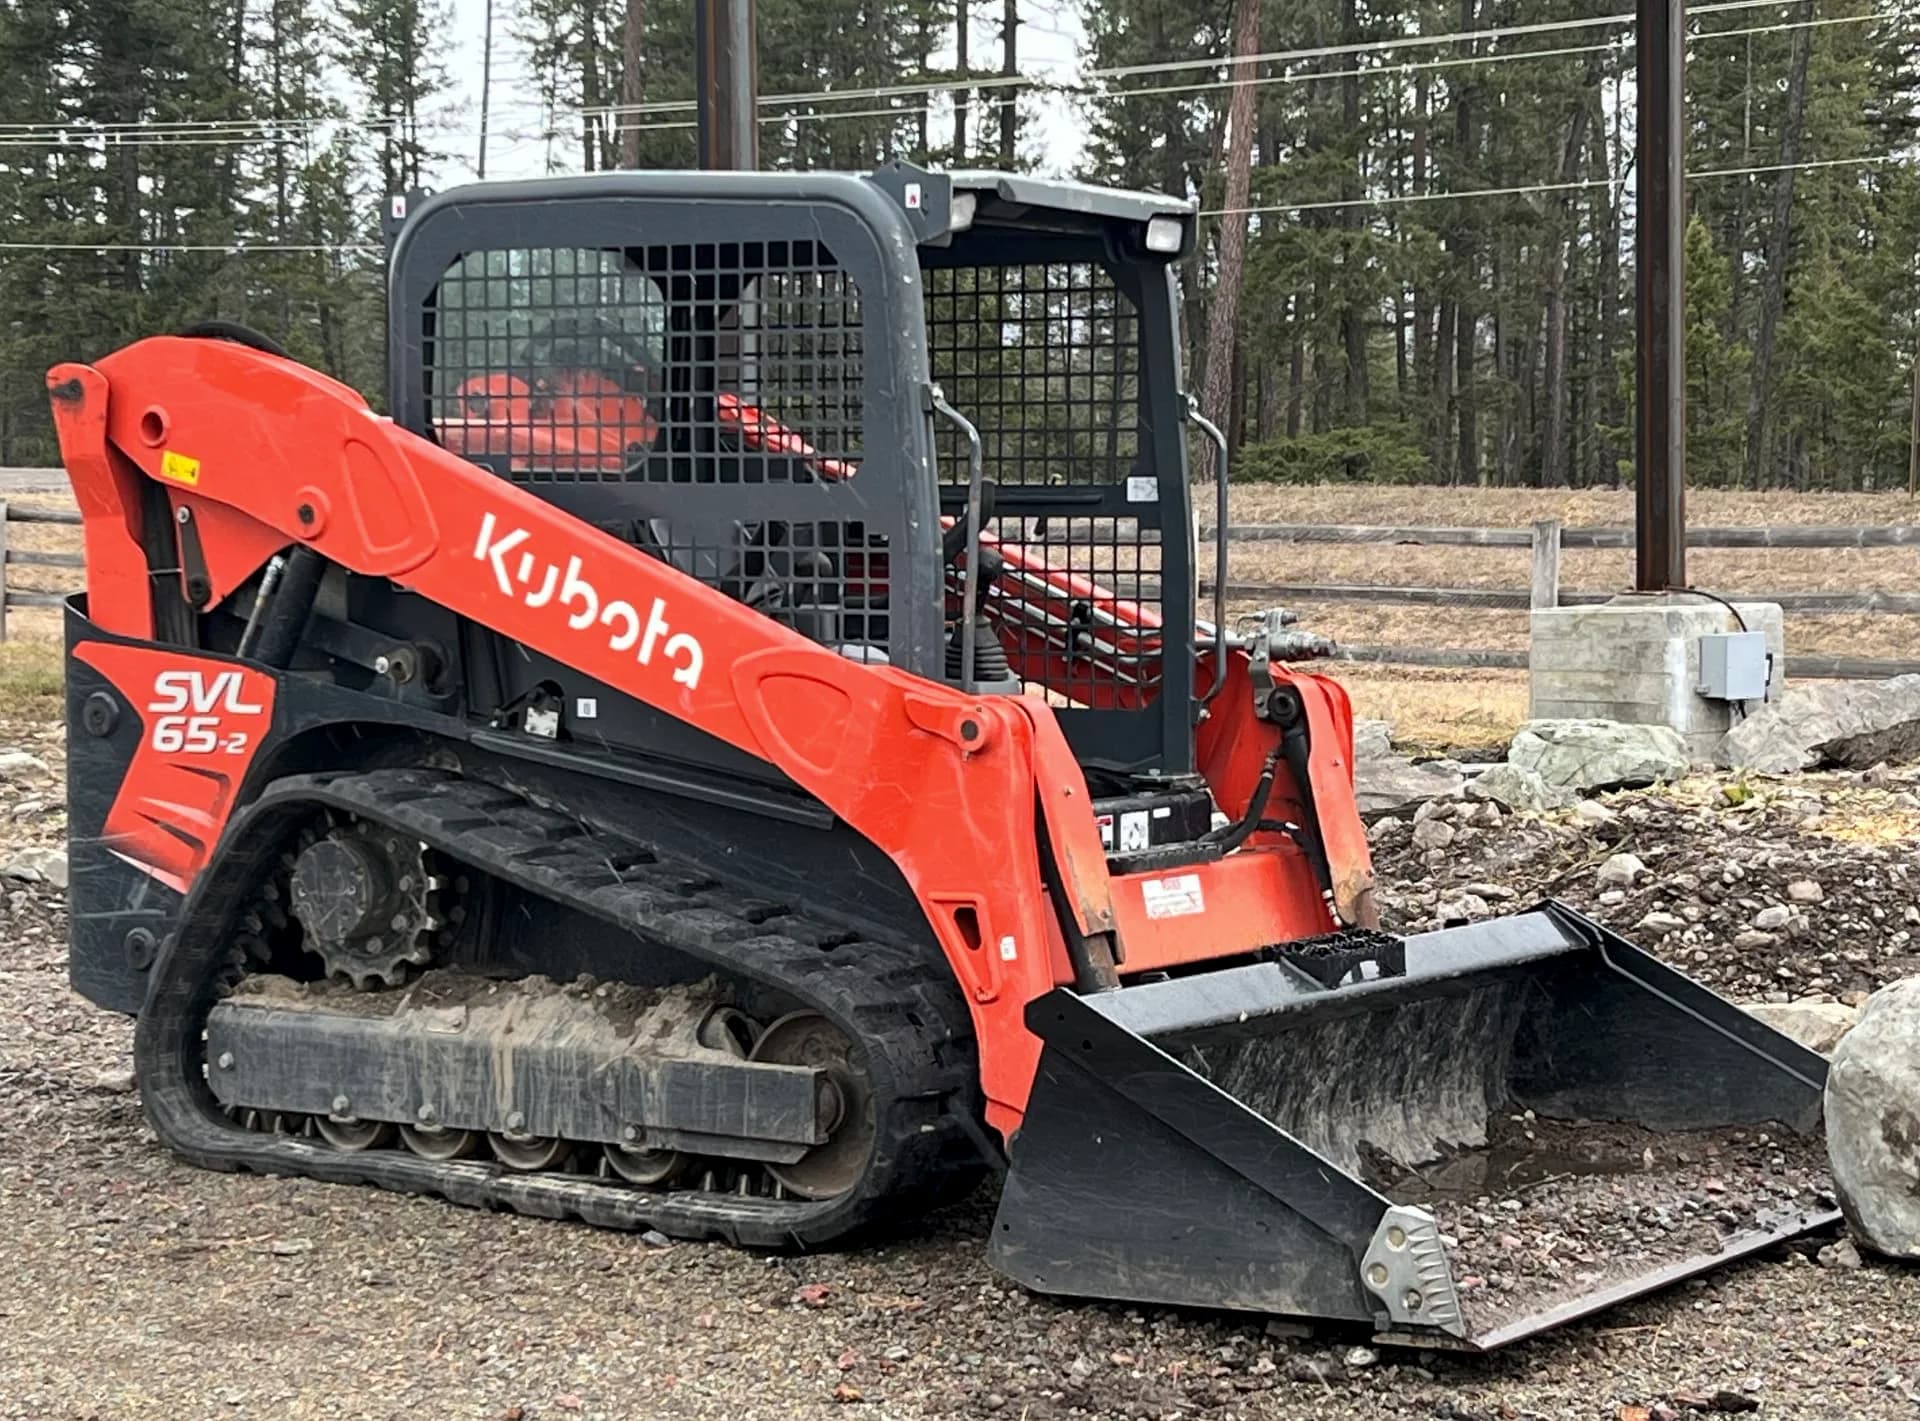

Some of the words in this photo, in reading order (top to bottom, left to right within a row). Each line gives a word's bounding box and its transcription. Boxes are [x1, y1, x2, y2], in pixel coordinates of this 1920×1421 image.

[473, 511, 704, 690] Kubota
[147, 670, 263, 714] SVL
[151, 715, 248, 755] 65-2
